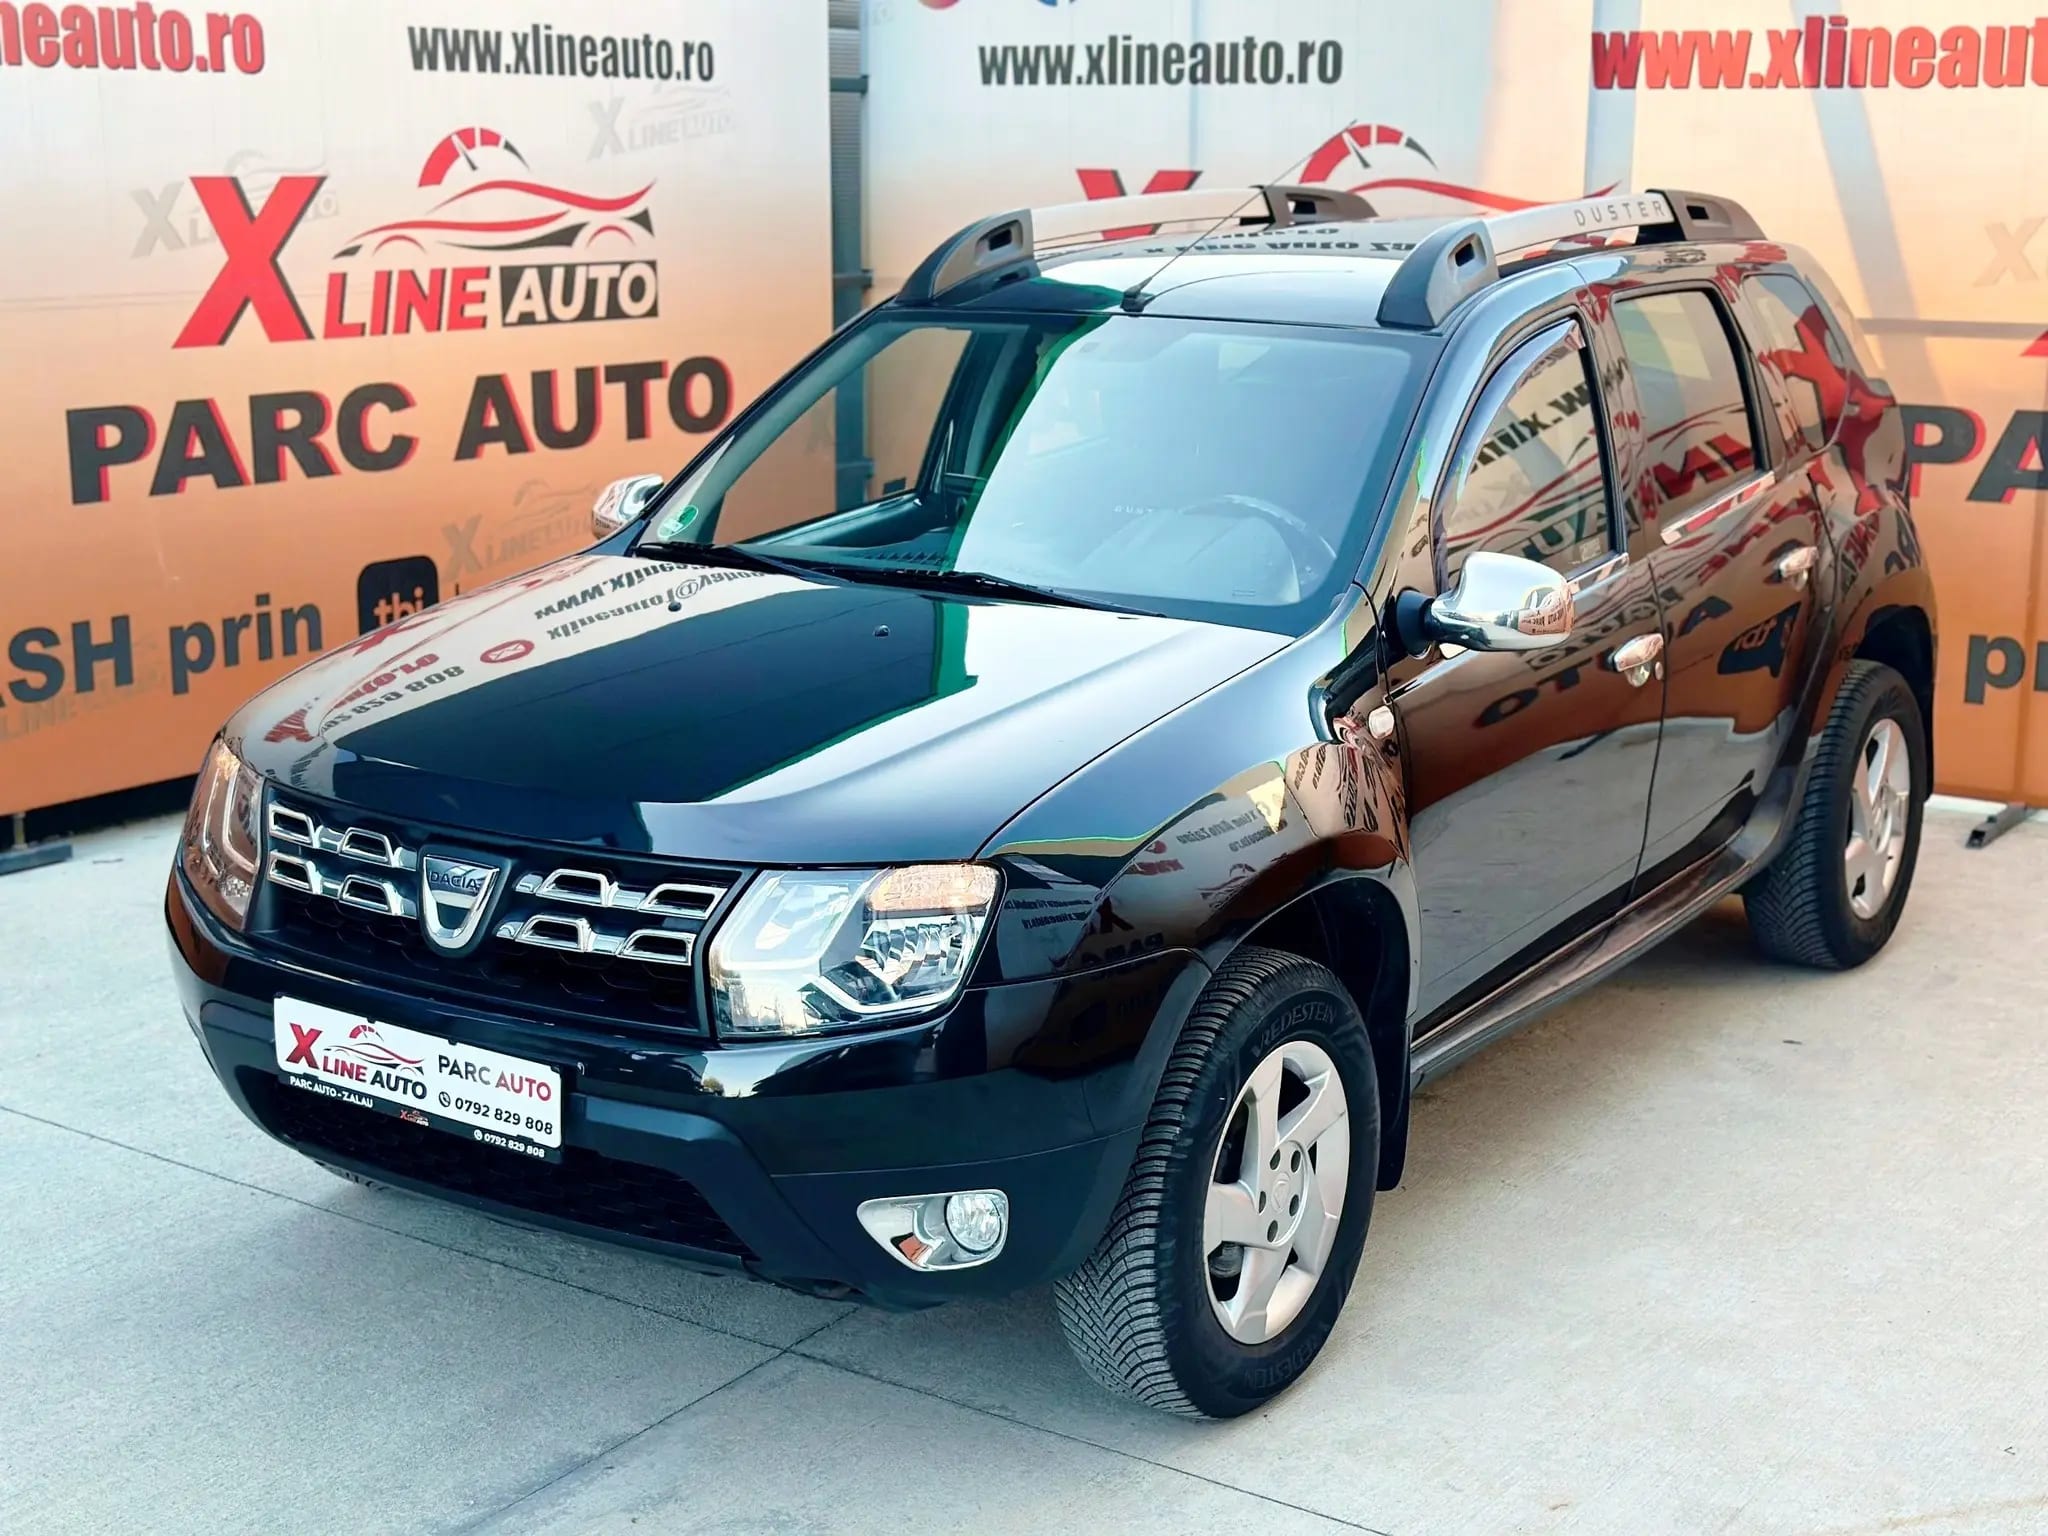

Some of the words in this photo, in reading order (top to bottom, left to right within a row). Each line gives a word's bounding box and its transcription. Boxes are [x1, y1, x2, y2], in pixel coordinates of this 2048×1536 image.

[408, 24, 715, 82] www.xlineauto.ro
[978, 36, 1343, 86] www.xlineauto.ro
[1574, 200, 1666, 226] DUSTER
[172, 175, 326, 348] X
[323, 266, 490, 340] LINE
[504, 262, 657, 325] AUTO
[66, 383, 418, 505] PARC
[453, 357, 733, 461] AUTO
[0, 615, 134, 708] SH
[169, 593, 323, 696] prin
[429, 871, 478, 890] DACIA
[286, 1022, 323, 1070] X
[322, 1055, 368, 1083] LINE
[370, 1070, 427, 1100] AUTO
[438, 1054, 491, 1086] PARC
[495, 1070, 552, 1102] AUTO
[289, 1076, 314, 1092] PARC
[313, 1081, 338, 1098] AUTO
[455, 1097, 490, 1119] 0792
[494, 1107, 521, 1126] 829
[525, 1116, 553, 1135] 808
[484, 1132, 507, 1147] 0792
[507, 1138, 525, 1152] 829
[526, 1143, 545, 1158] 808
